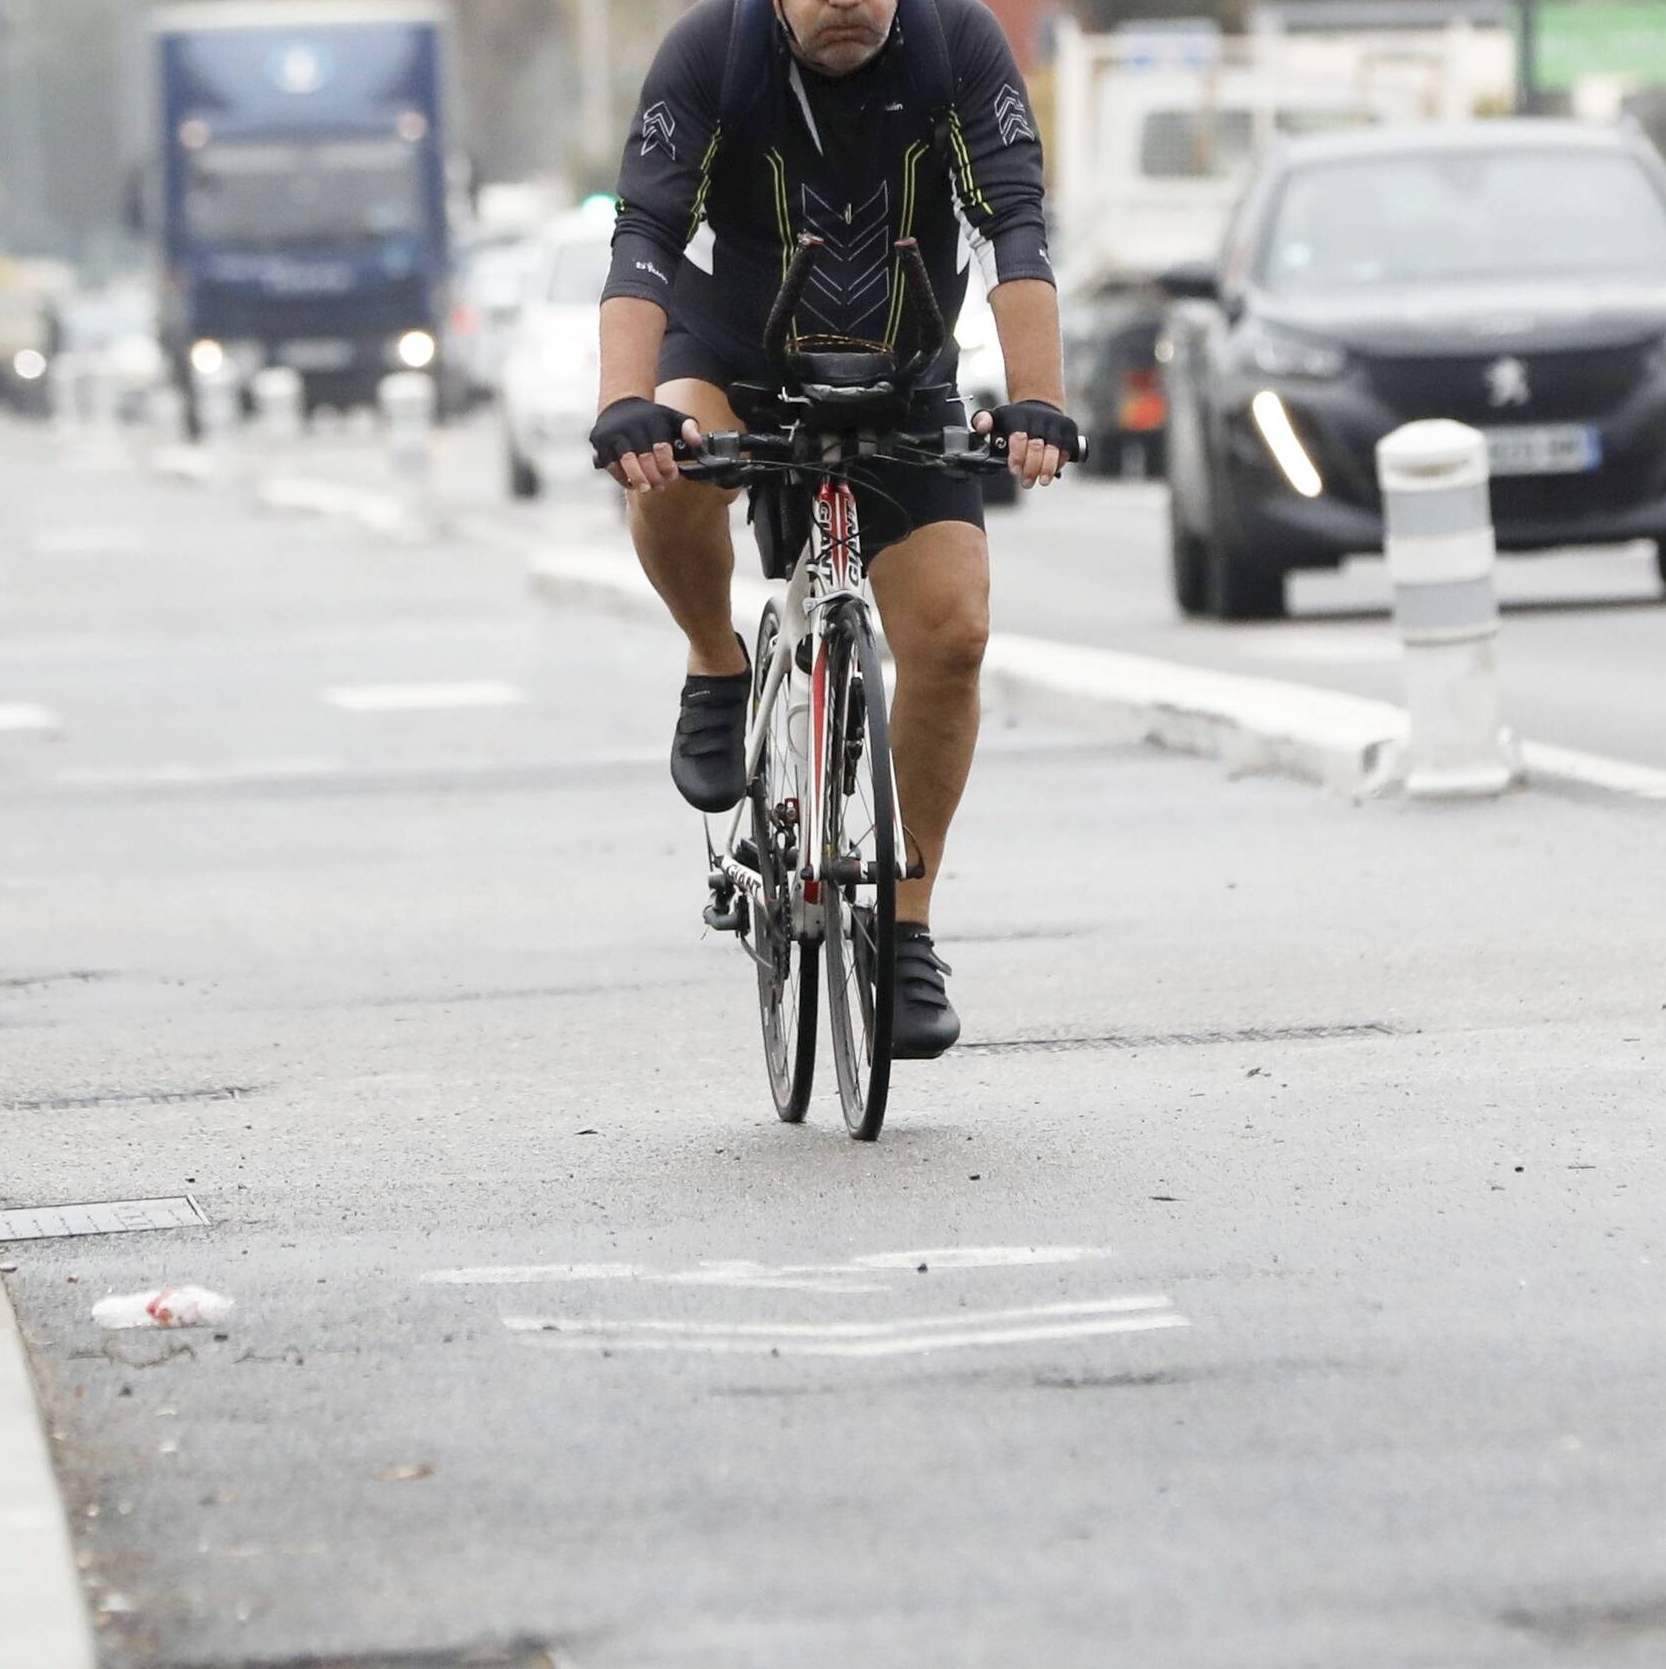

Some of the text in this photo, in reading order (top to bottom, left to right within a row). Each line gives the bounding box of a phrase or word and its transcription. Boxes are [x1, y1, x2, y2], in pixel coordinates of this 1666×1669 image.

[819, 499, 834, 587] GIANT
[844, 498, 865, 587] GIANT
[726, 863, 762, 901] GIANT
